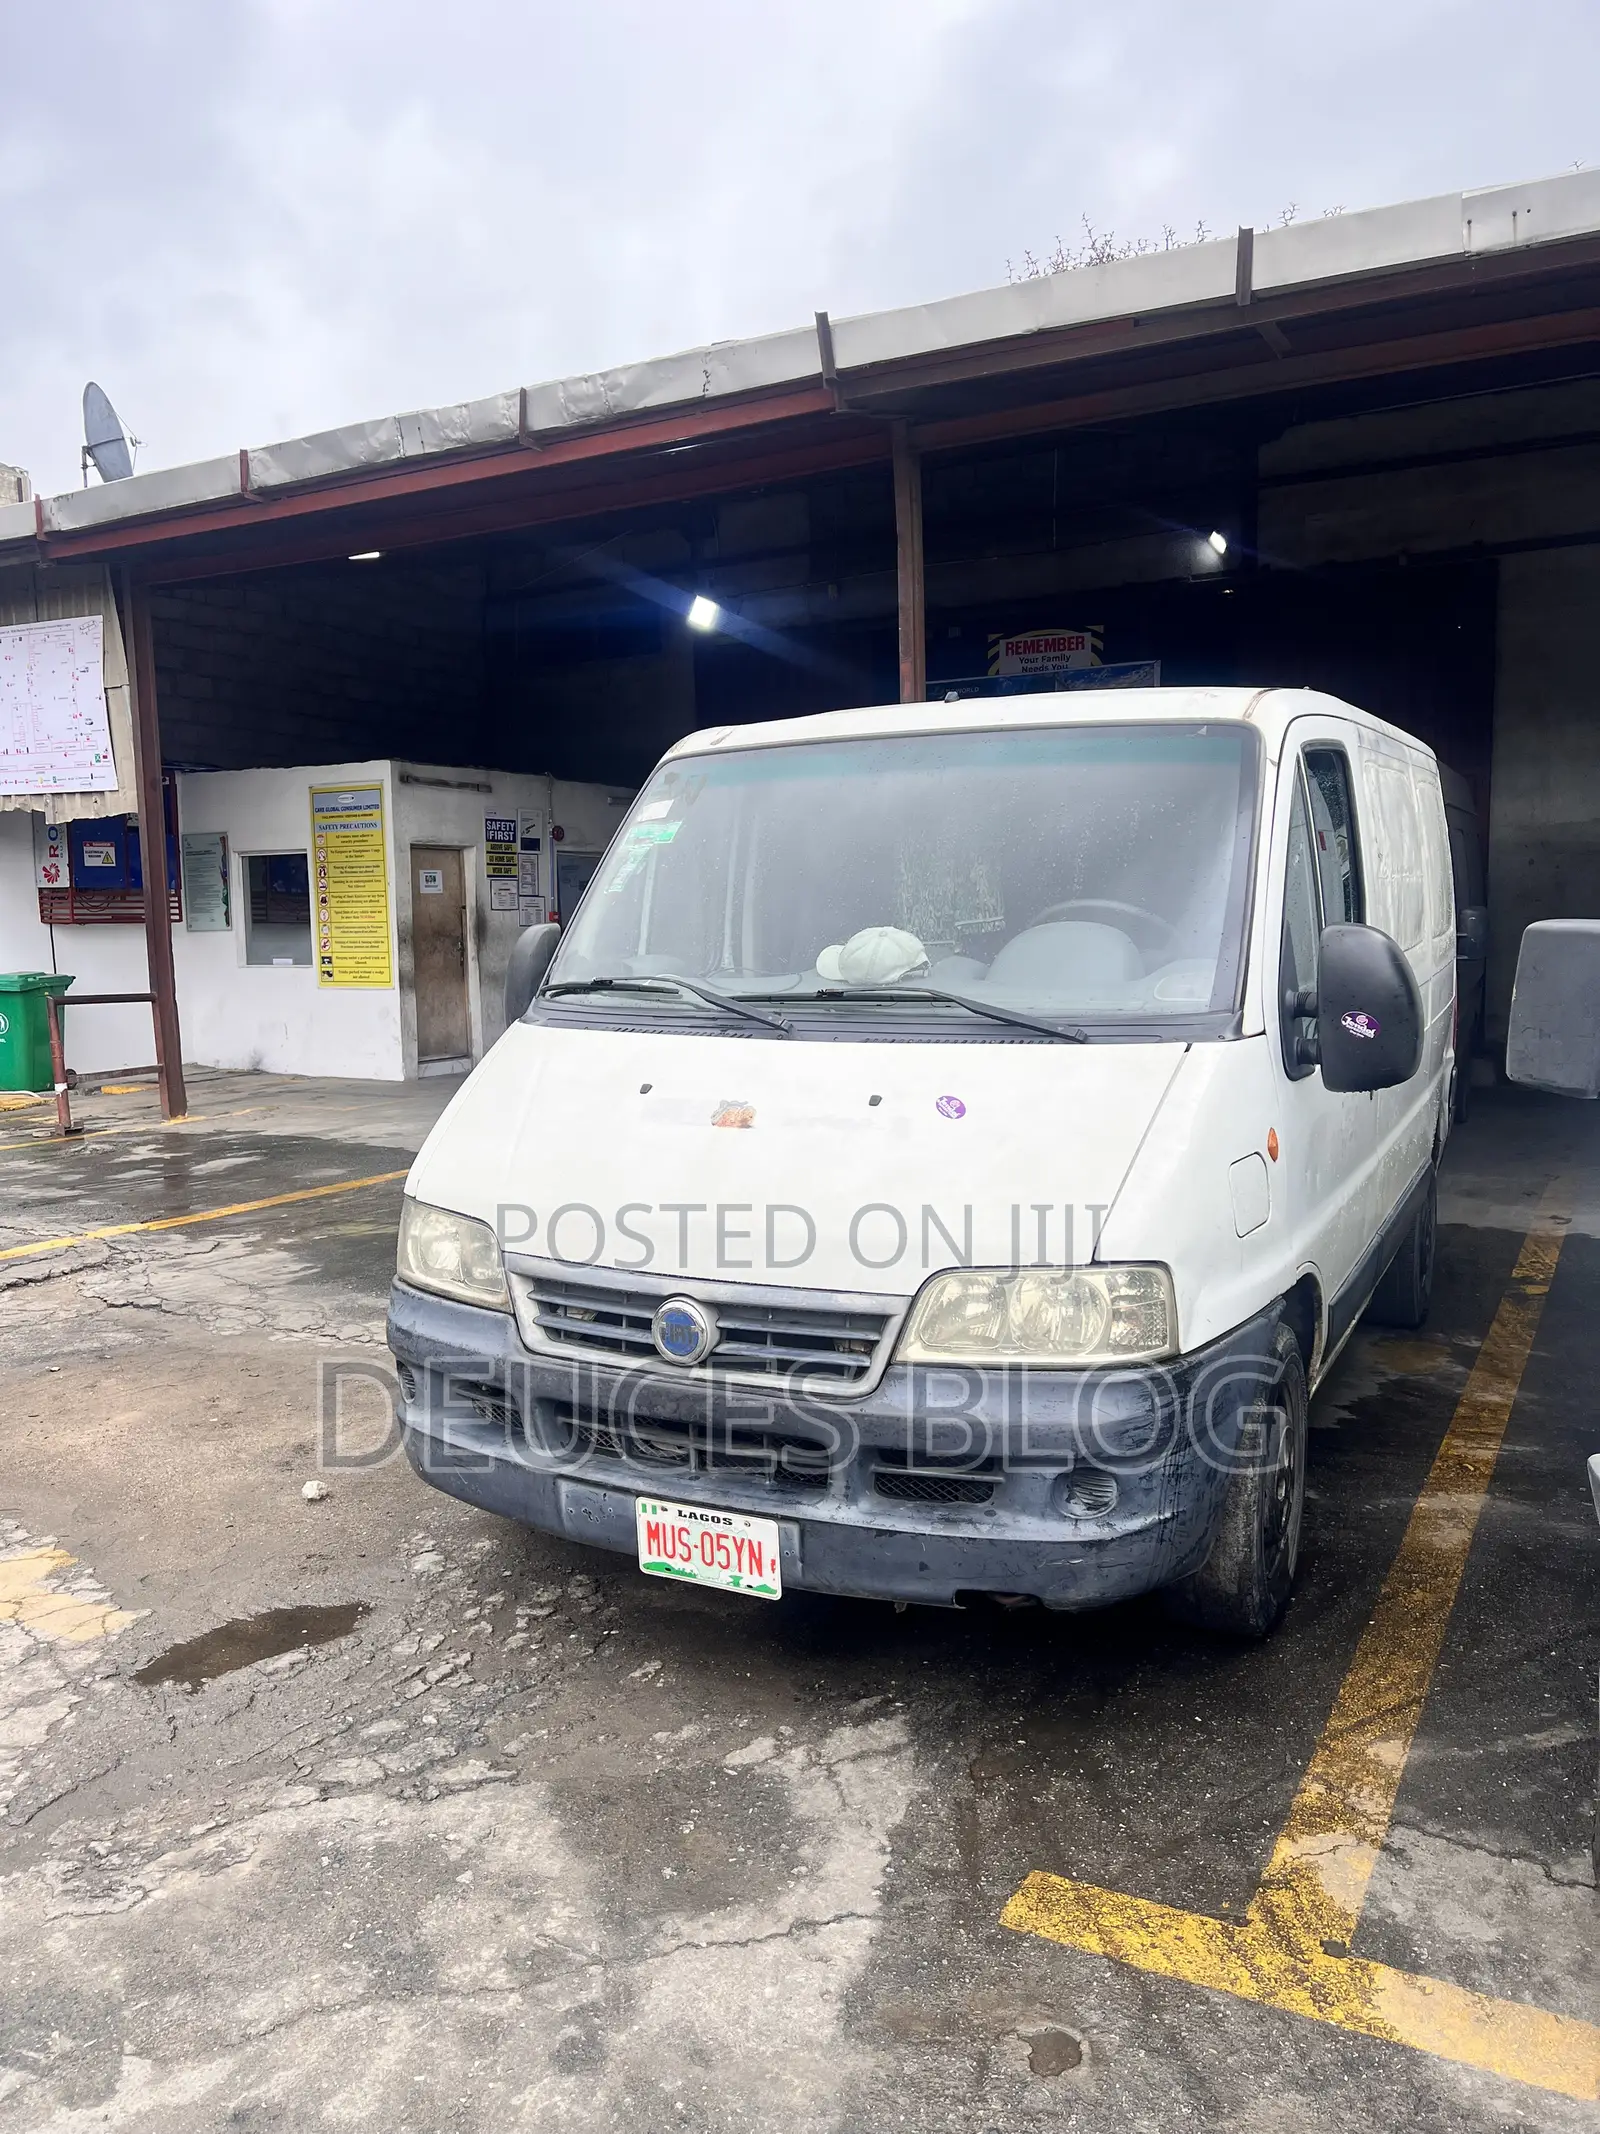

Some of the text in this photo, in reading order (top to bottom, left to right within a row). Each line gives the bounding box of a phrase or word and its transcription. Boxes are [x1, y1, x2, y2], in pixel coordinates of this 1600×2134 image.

[1005, 635, 1085, 657] REMEMBER
[1019, 653, 1071, 664] Your Family
[1021, 663, 1069, 673] Needs You
[318, 821, 378, 831] SAFETY PRECAUTIONS
[486, 820, 515, 832] SAFETY
[489, 830, 515, 841] FIRST
[677, 1508, 733, 1526] LAGOS
[646, 1519, 763, 1578] MUS-05YN
